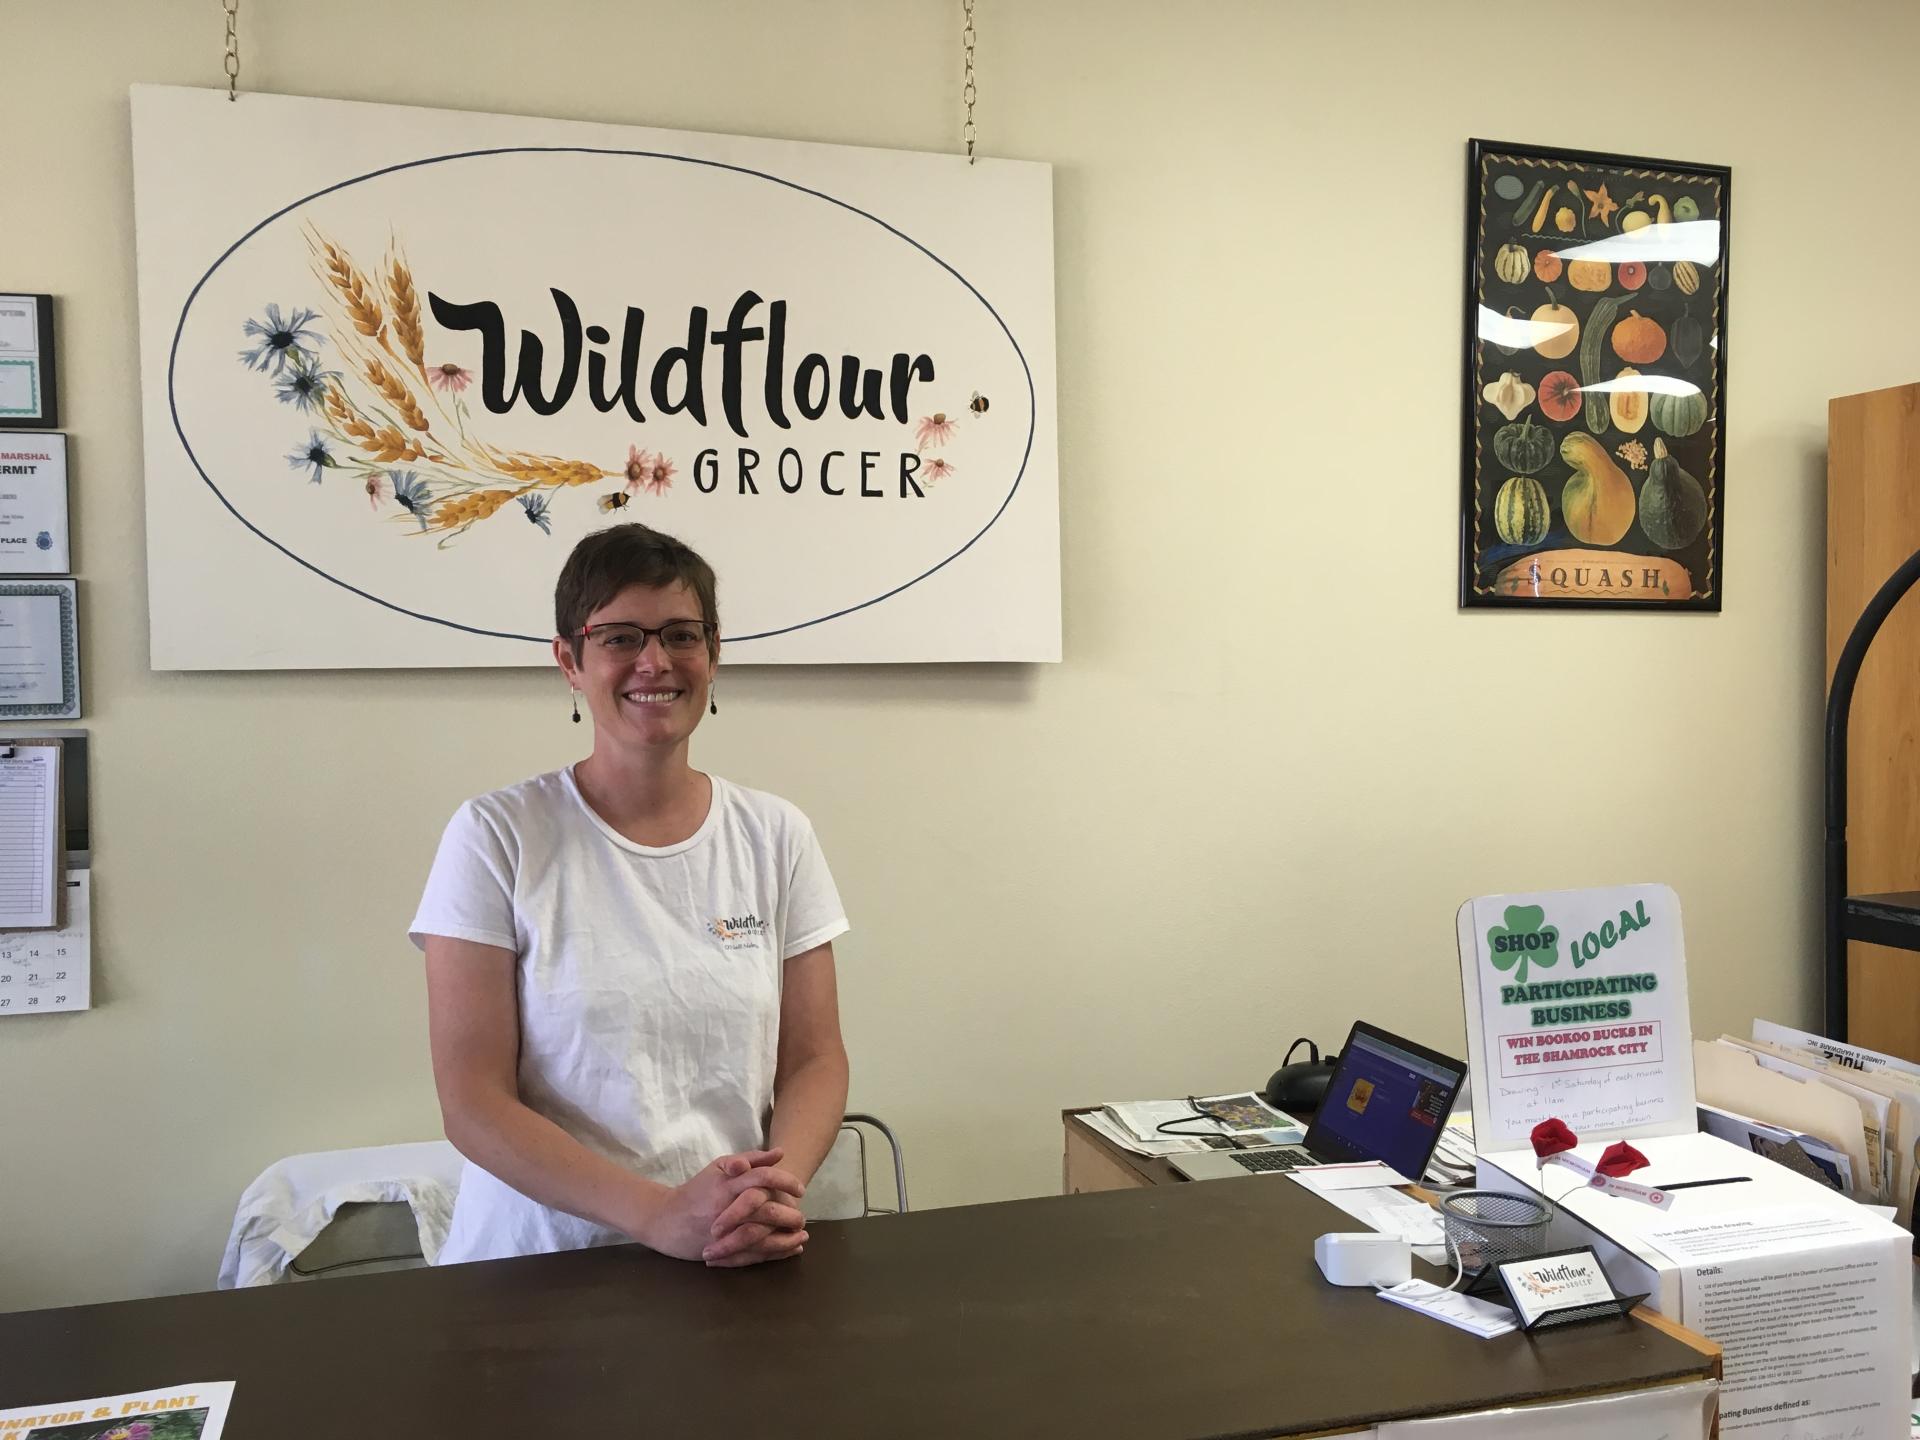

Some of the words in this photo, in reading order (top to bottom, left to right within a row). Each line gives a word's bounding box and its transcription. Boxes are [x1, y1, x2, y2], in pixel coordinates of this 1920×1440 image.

[428, 288, 934, 437] Wildflour
[0, 452, 51, 461] MARSHAL
[0, 465, 37, 475] RMIT
[693, 447, 925, 498] GROCER
[1528, 564, 1661, 589] SQUASH
[1494, 931, 1556, 953] SHOP
[1570, 900, 1650, 969] LOCAL
[0, 975, 11, 983] 20
[28, 973, 38, 981] 21
[56, 972, 66, 980] 22
[1502, 974, 1657, 1003] PARTICIPATING
[0, 999, 11, 1007] 27
[28, 997, 38, 1005] 28
[1532, 1001, 1630, 1025] BUSINESS
[1507, 1037, 1533, 1049] WIN
[1536, 1031, 1590, 1046] BOOKOO
[1593, 1027, 1636, 1041] BUCKS
[1639, 1025, 1653, 1036] IN
[1514, 1053, 1540, 1065] THE
[1543, 1045, 1616, 1062] SHAMROCK
[1618, 1042, 1648, 1055] CITY
[1819, 1042, 1854, 1057] HARDWARE
[1534, 1264, 1586, 1283] Wildflour
[1696, 1265, 1723, 1277] Details:
[92, 1406, 112, 1418] &
[121, 1395, 199, 1414] PLANT
[1742, 1404, 1772, 1417] Business
[1773, 1399, 1799, 1412] defined
